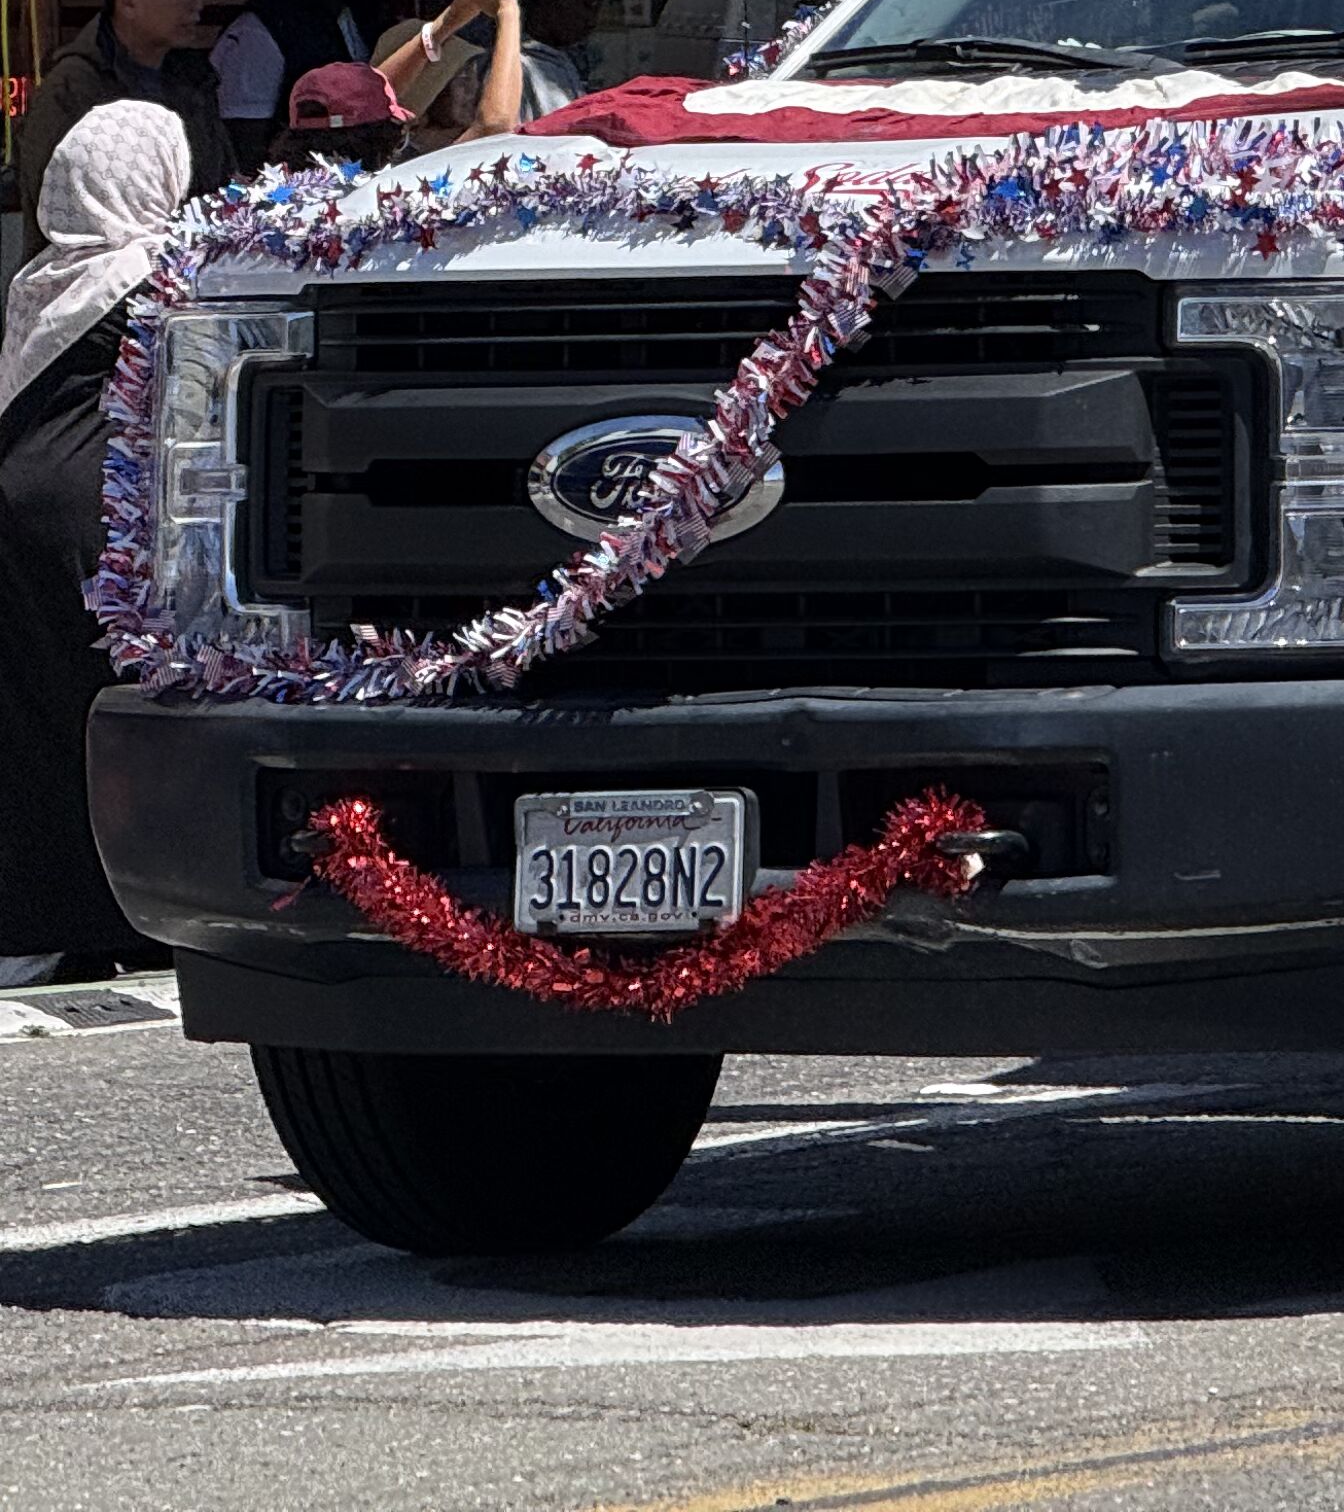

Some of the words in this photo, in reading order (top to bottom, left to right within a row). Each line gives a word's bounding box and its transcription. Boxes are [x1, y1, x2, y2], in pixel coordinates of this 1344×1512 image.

[574, 800, 606, 813] SAN
[612, 799, 687, 812] LEANDRO
[530, 844, 727, 910] 31828N2
